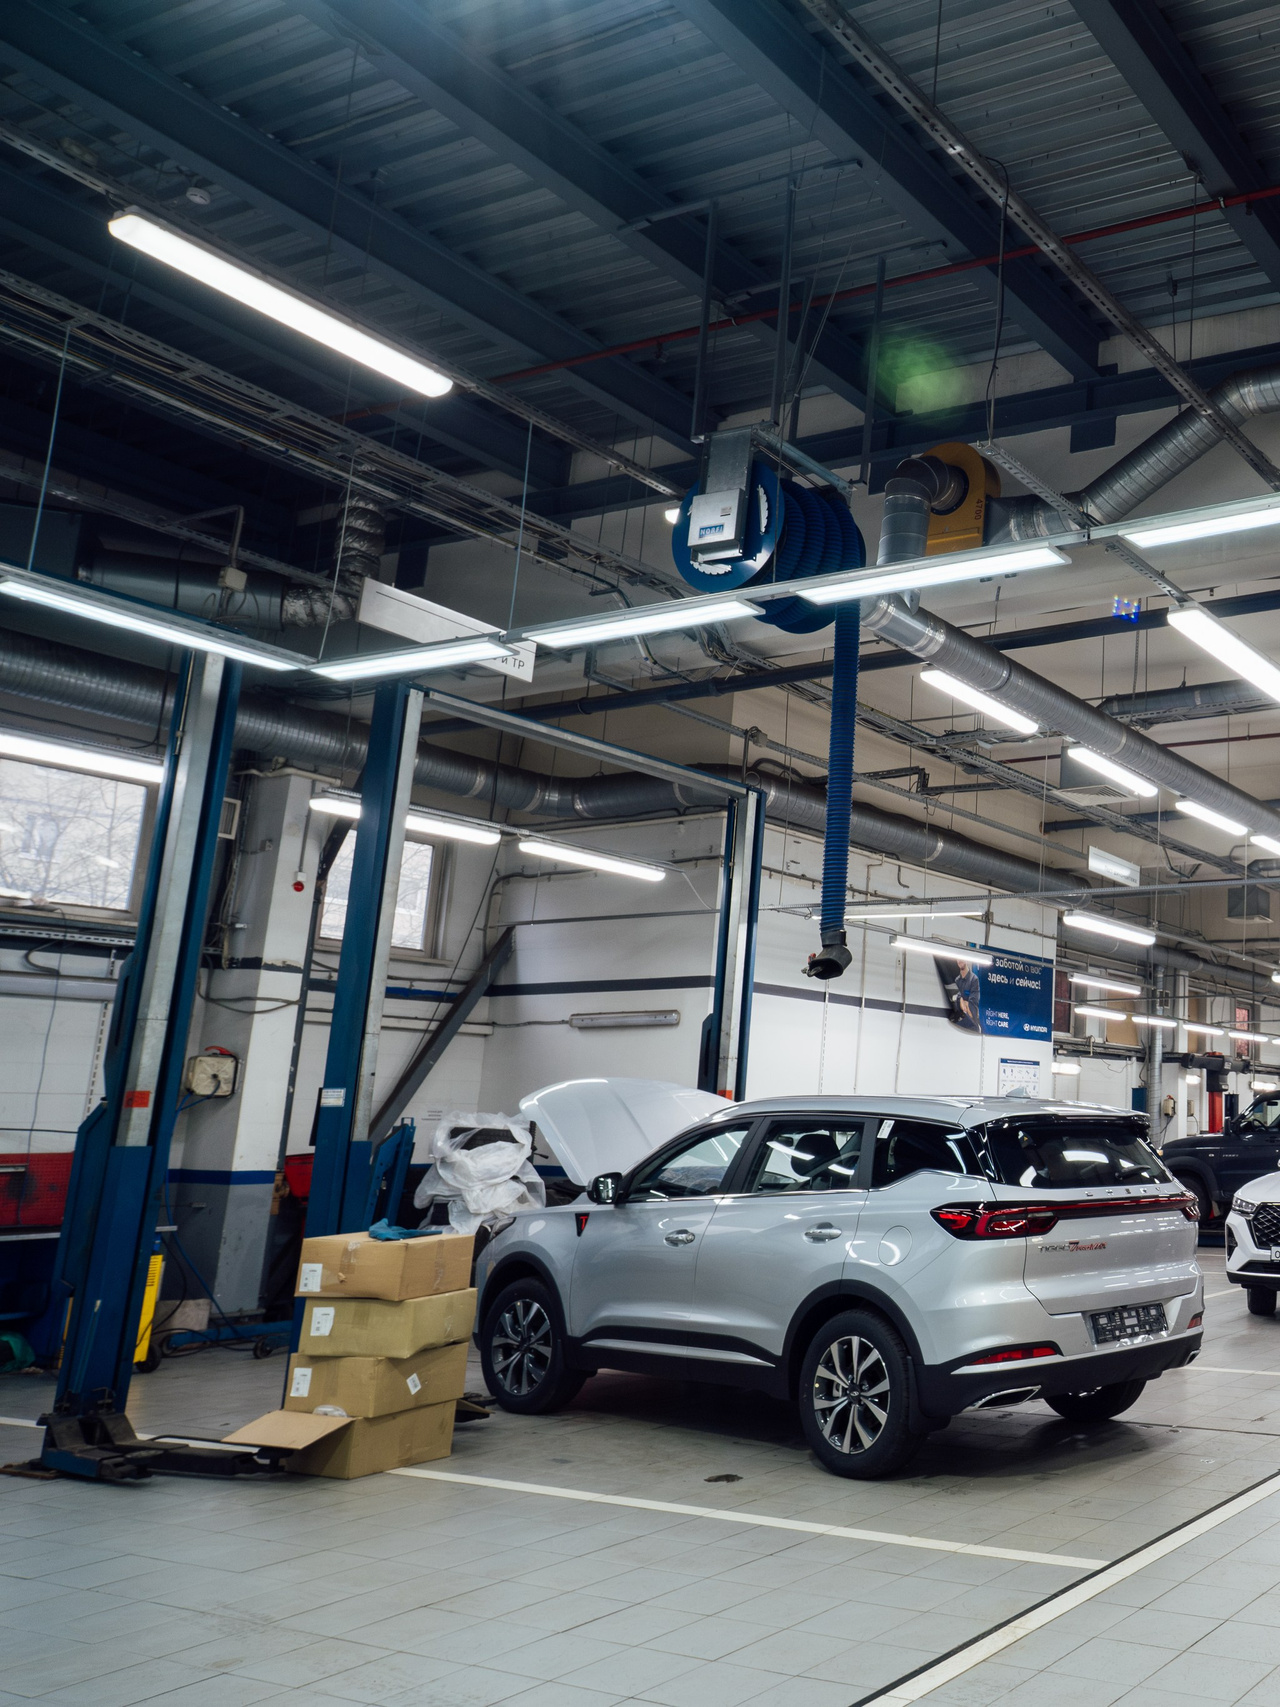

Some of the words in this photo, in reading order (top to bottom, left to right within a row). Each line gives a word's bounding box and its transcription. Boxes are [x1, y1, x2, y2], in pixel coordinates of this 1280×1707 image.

[974, 498, 983, 520] 4700
[995, 958, 1024, 972] заботой
[987, 972, 1008, 984] здесь
[1009, 977, 1015, 985] и
[1015, 976, 1041, 990] сейчас!
[997, 1020, 1009, 1028] CARE
[1030, 1024, 1048, 1033] HYUNDAI
